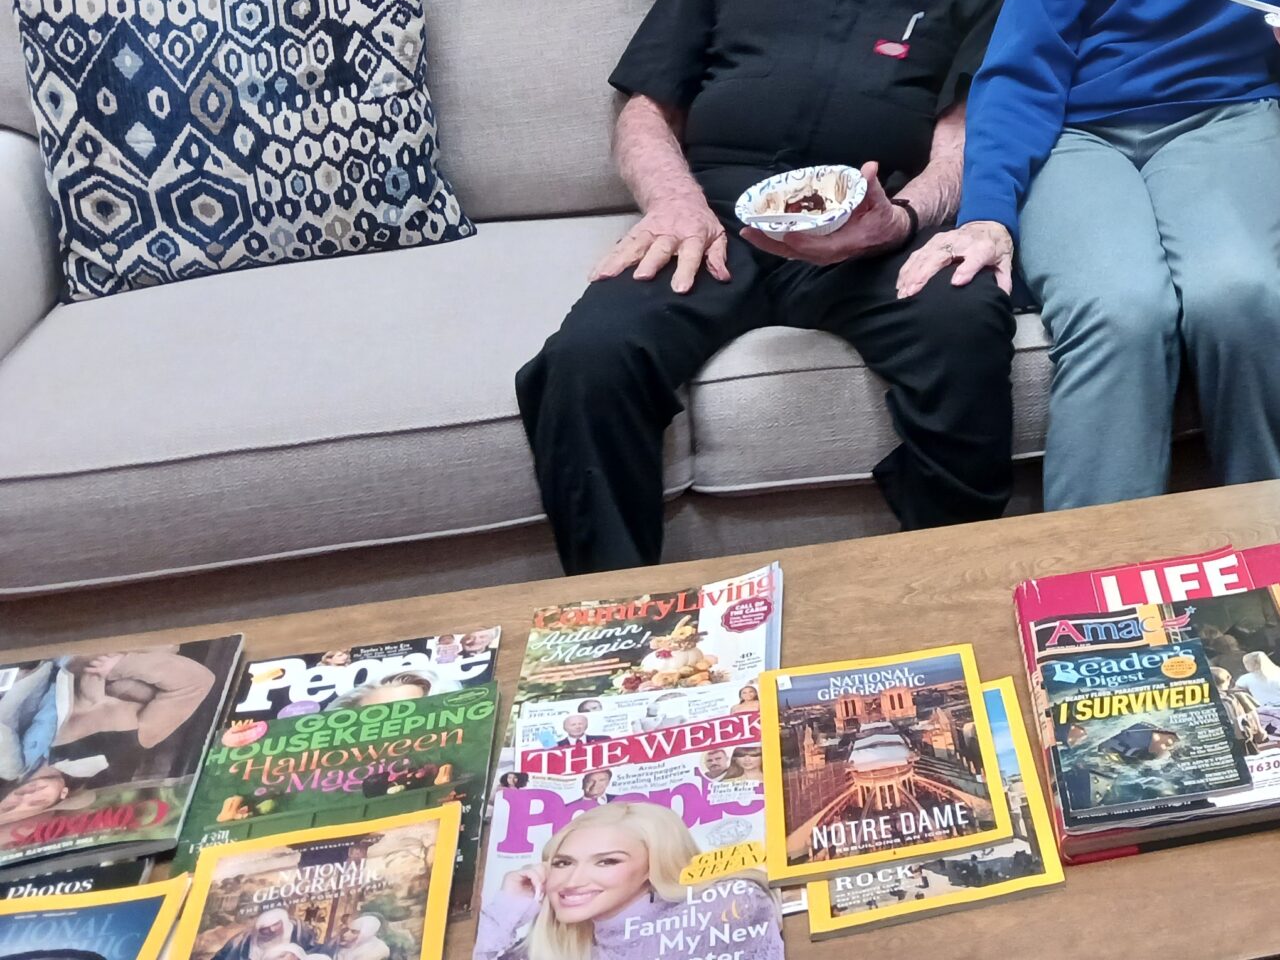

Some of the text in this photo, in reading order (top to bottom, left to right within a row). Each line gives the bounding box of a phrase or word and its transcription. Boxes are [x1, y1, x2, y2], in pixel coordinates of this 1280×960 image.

[1101, 554, 1247, 612] LIFE
[531, 623, 643, 650] Autumn
[542, 632, 652, 663] Magic!
[829, 667, 915, 689] NATIONAL
[1052, 646, 1196, 684] Reader's
[1084, 671, 1145, 688] Digest
[817, 674, 926, 702] GEOGRAPHIC
[1059, 702, 1069, 725] I
[1075, 682, 1211, 722] SURVIVED!
[1065, 693, 1090, 702] DEADLY
[205, 700, 496, 766] HOUSEKEEPING
[295, 700, 417, 733] GOOD
[229, 727, 464, 786] Halloween
[526, 740, 633, 776] THE
[635, 711, 762, 759] WEEK
[286, 757, 411, 794] Magic
[653, 769, 691, 780] Interview
[497, 766, 765, 854] Peple
[812, 801, 970, 850] NOTRE DAME
[836, 838, 901, 853] REBUILDING
[924, 829, 950, 838] ICON
[252, 869, 384, 904] GEOGRAPHIC
[278, 858, 367, 883] NATIONAL
[834, 864, 914, 891] ROCK
[7, 878, 94, 900] Photos
[239, 907, 259, 916] THE
[262, 897, 307, 910] HEALING
[310, 891, 346, 901] POWER
[687, 879, 754, 905] Love,
[0, 912, 116, 945] TIONAL
[624, 906, 712, 940] Family
[659, 929, 701, 955] My
[709, 921, 769, 947] New
